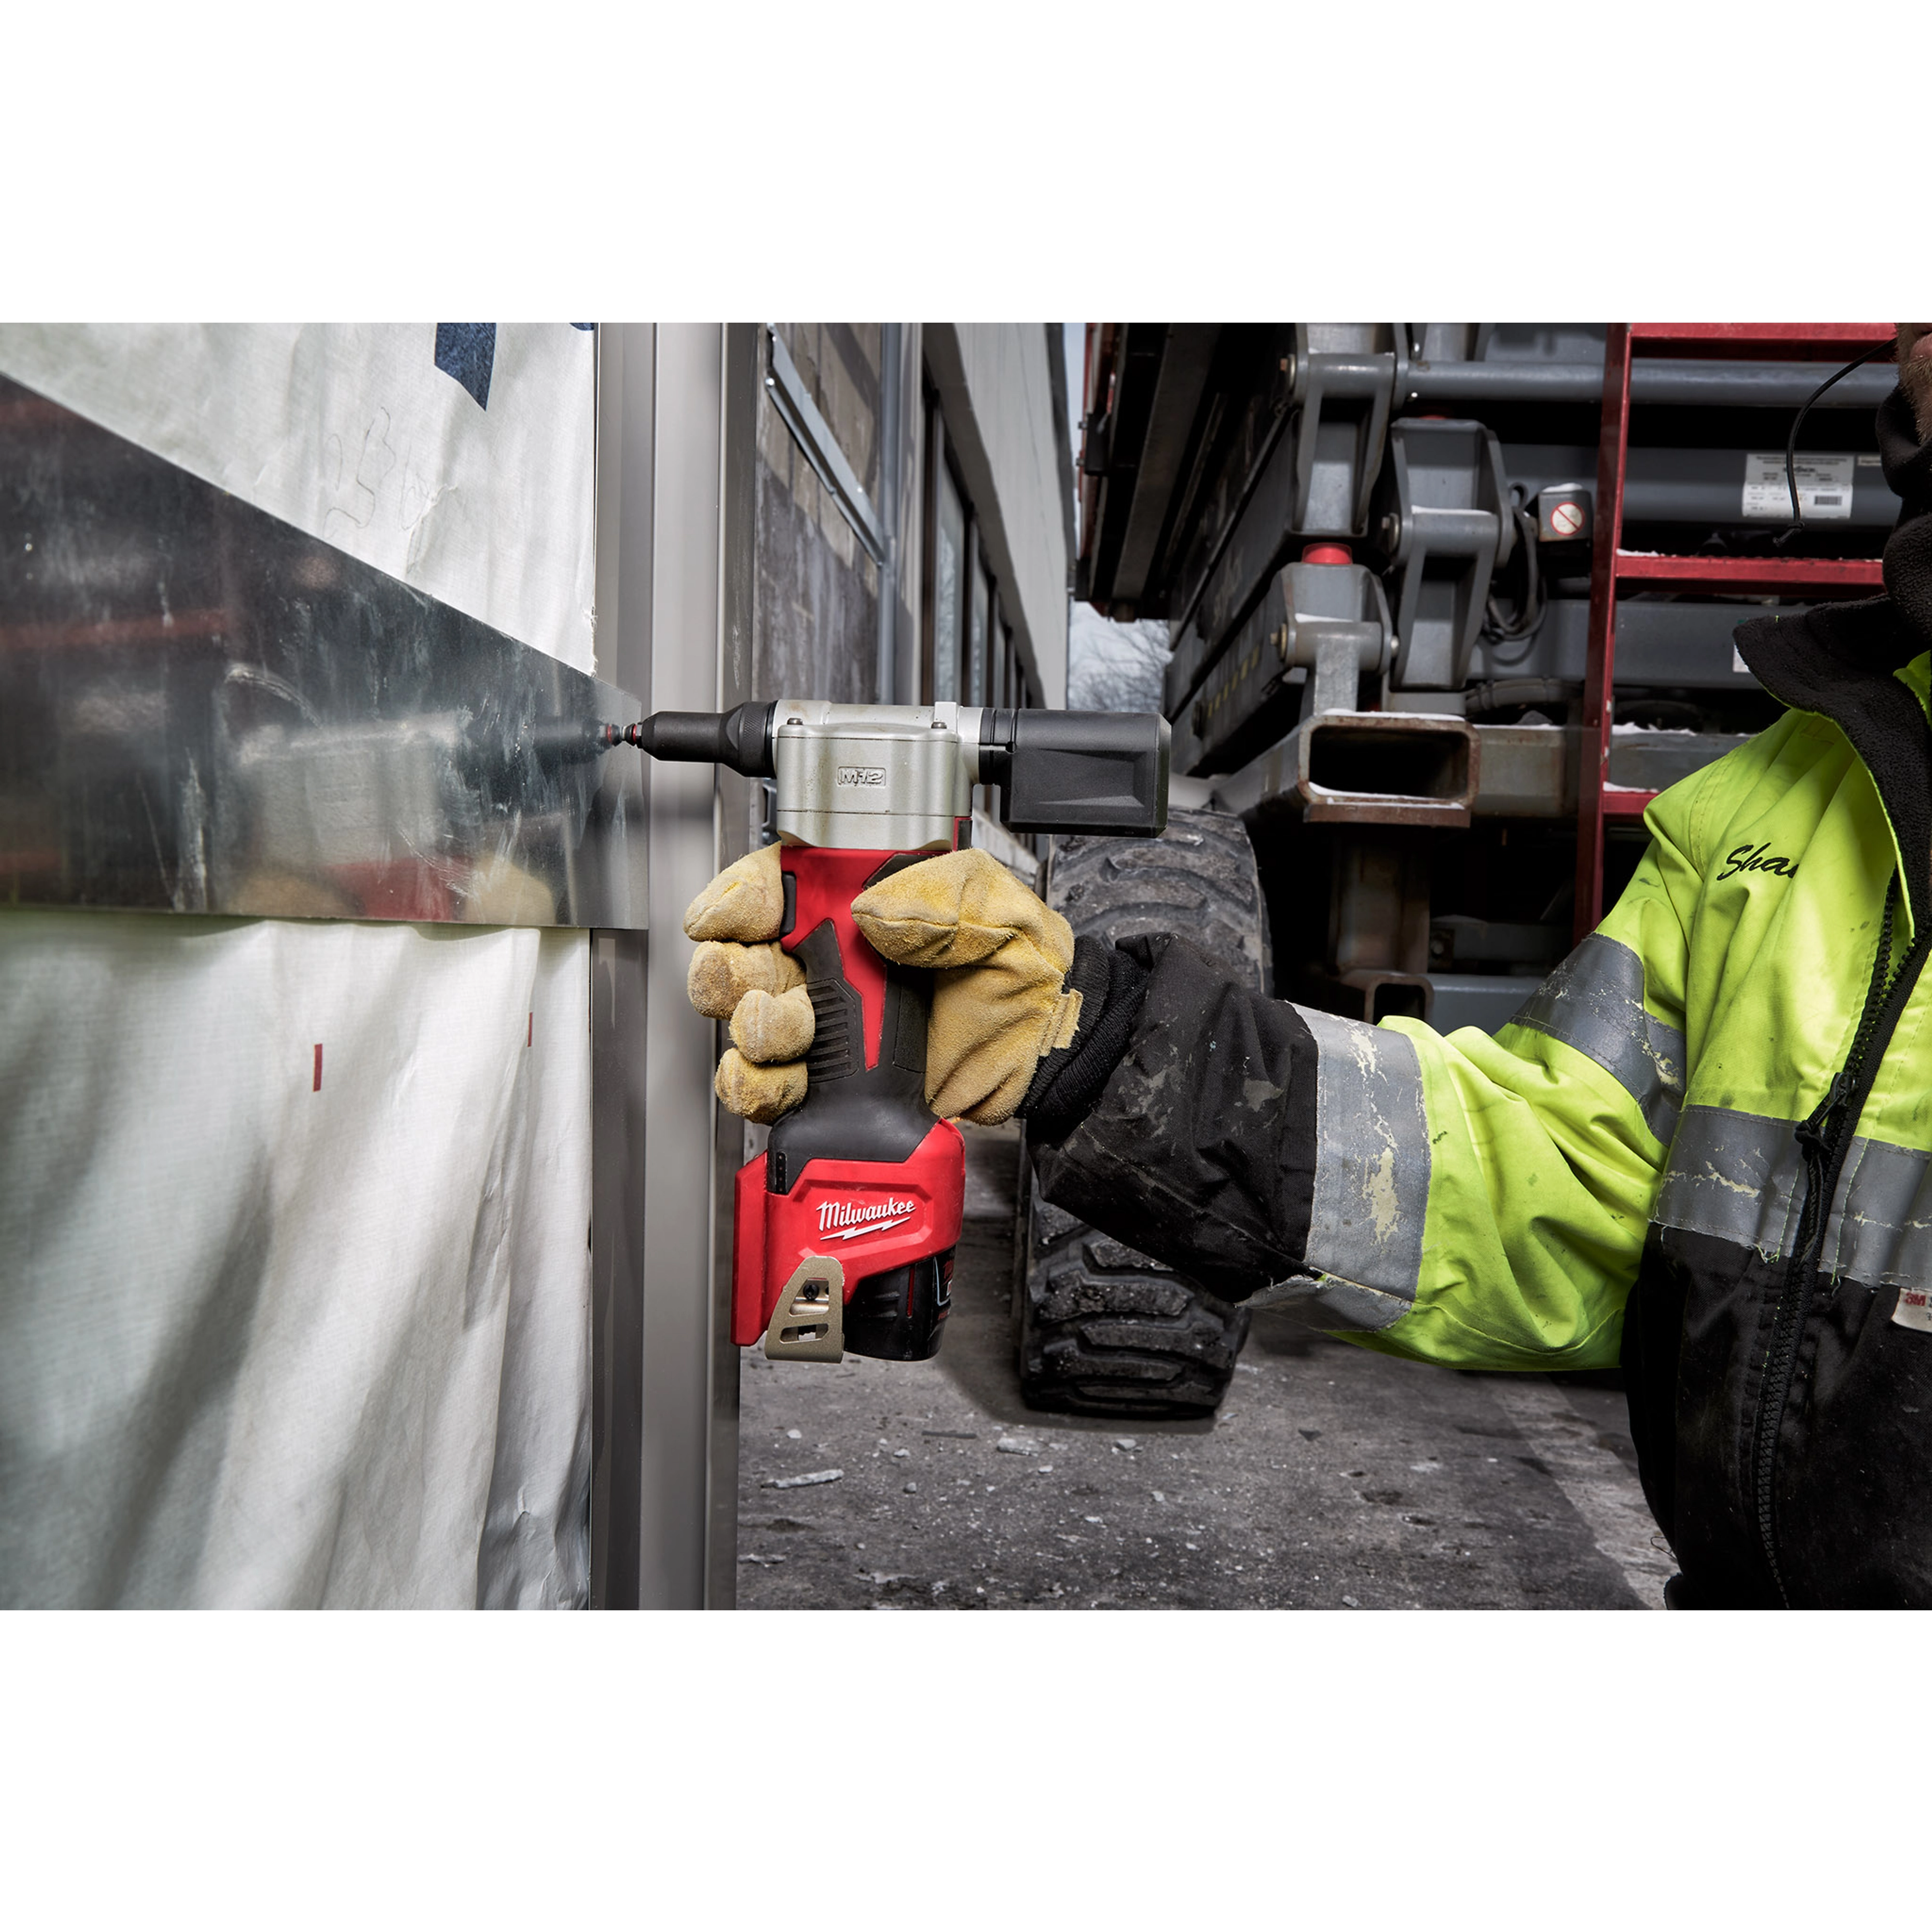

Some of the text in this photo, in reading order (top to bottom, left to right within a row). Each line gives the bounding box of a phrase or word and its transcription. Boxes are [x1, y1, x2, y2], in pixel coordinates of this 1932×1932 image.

[838, 768, 884, 785] M12
[816, 1198, 916, 1231] Milwaukee
[1904, 1291, 1926, 1307] 3M
